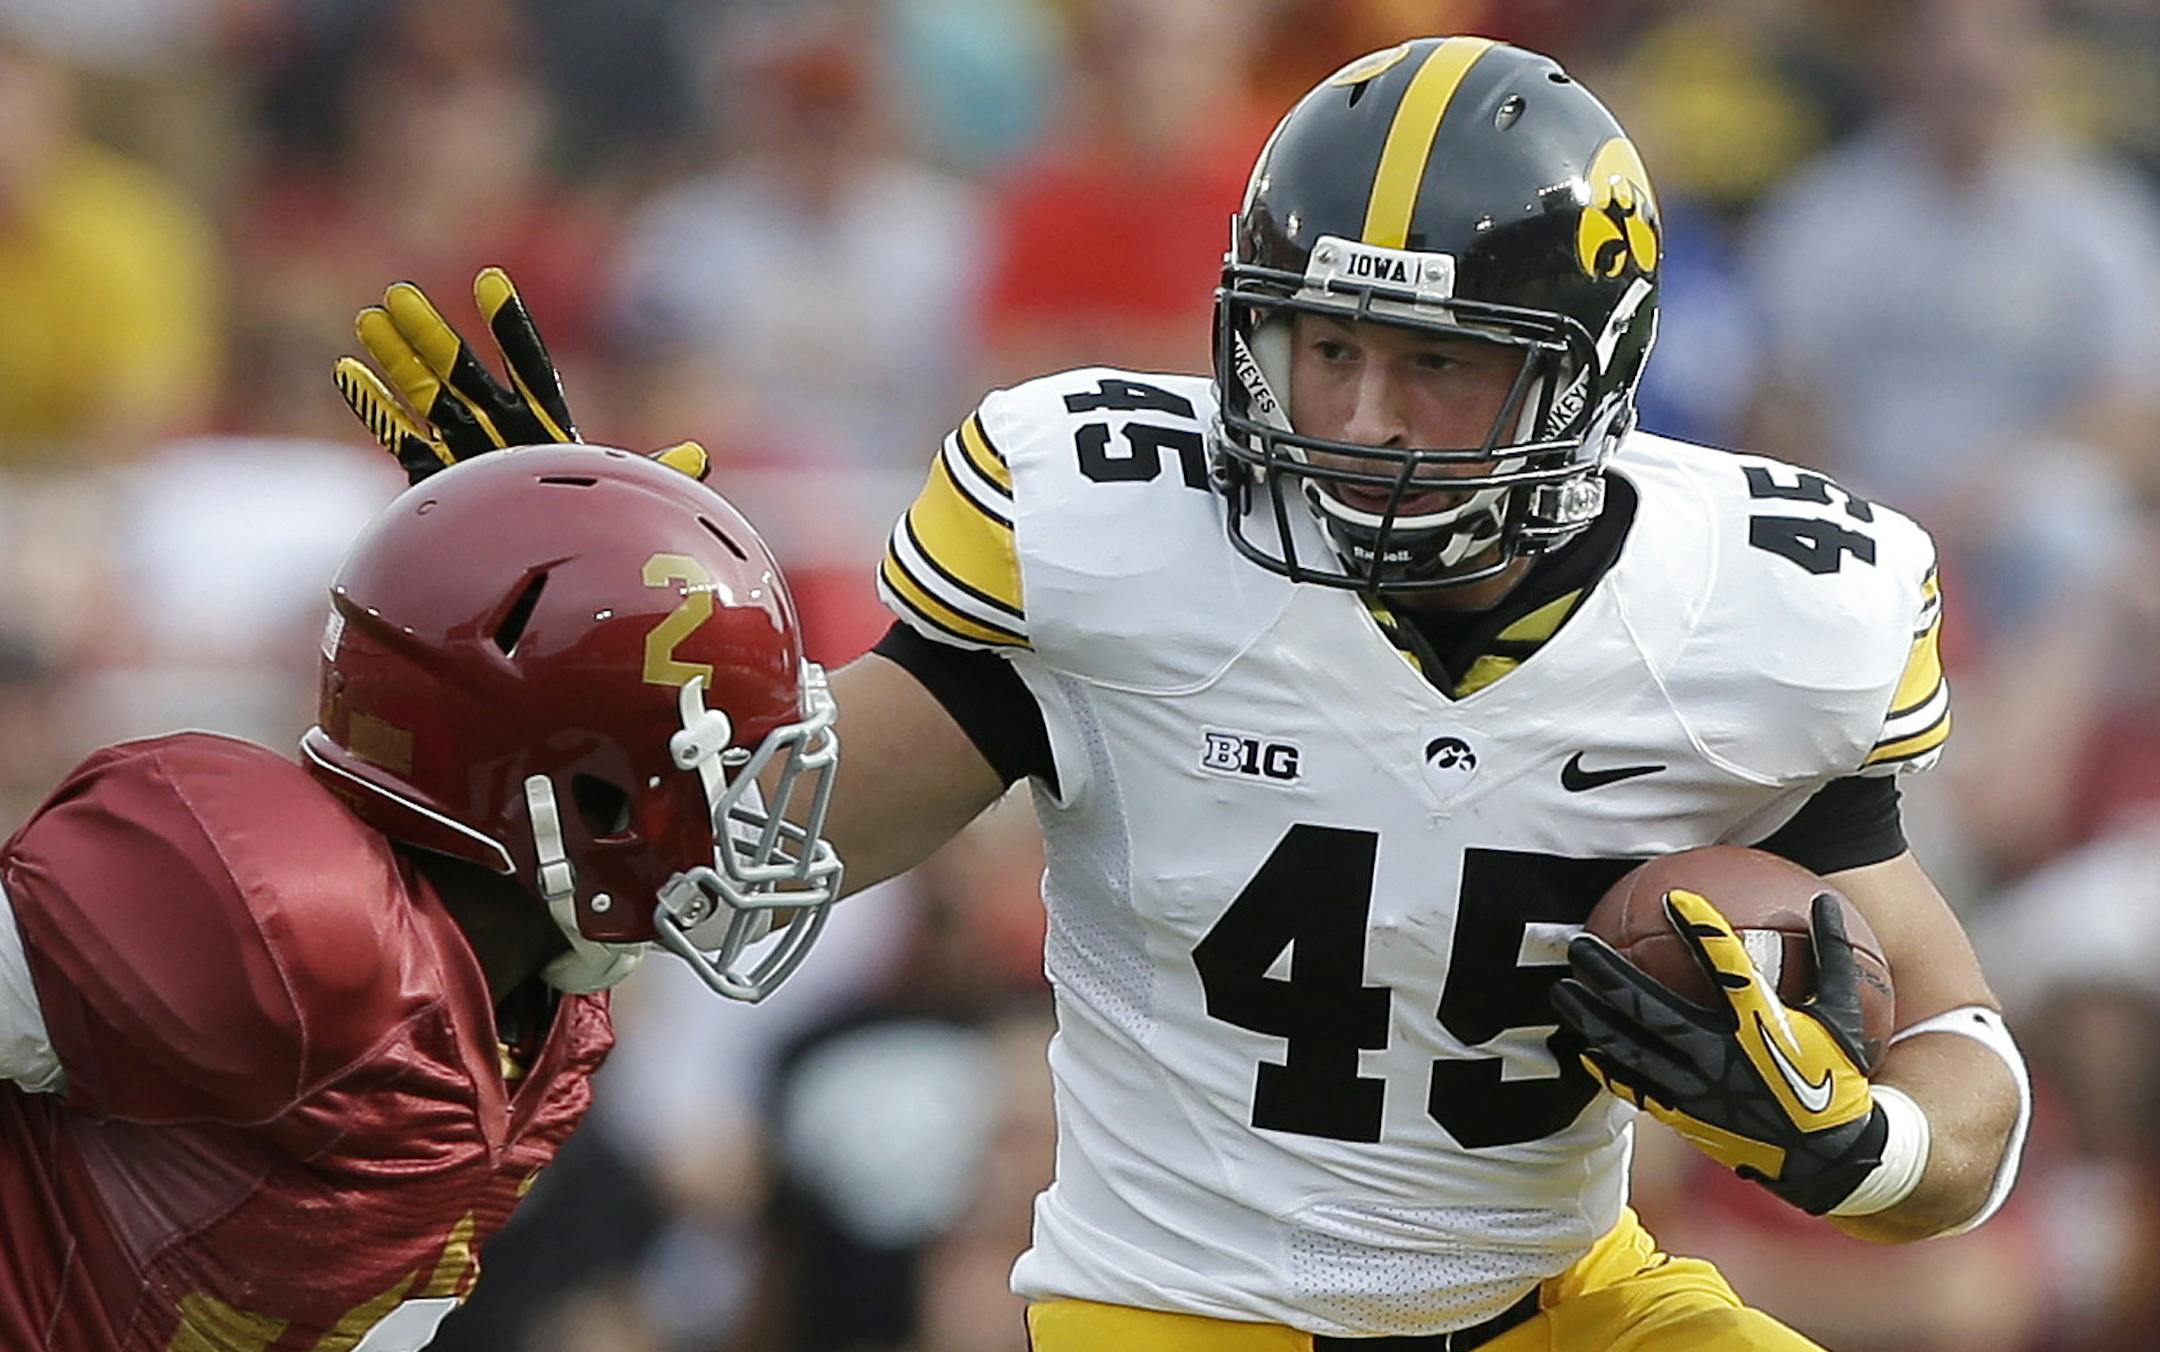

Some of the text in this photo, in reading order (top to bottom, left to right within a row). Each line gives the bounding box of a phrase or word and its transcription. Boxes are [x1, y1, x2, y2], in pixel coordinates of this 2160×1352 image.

[1347, 253, 1407, 283] IOWA
[1063, 379, 1211, 493] 45
[1741, 465, 1876, 575] 45
[642, 552, 714, 690] 2
[1191, 823, 1650, 1149] 45
